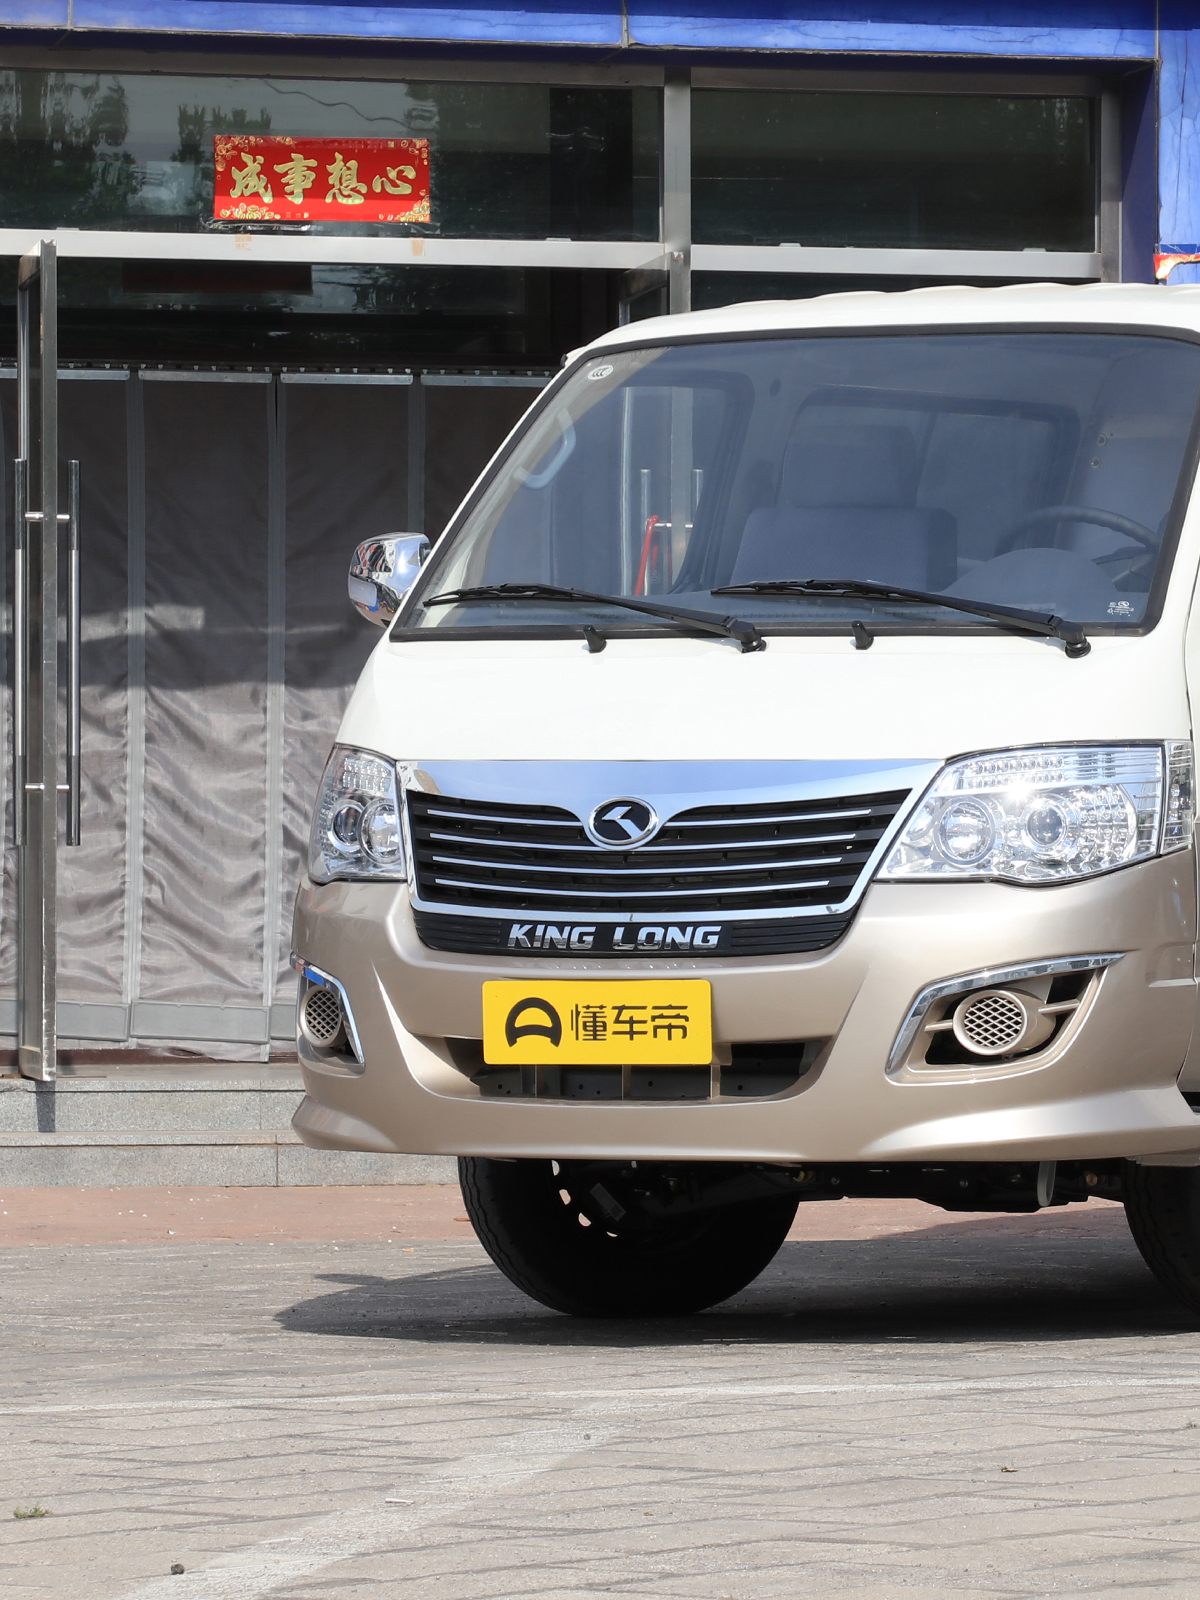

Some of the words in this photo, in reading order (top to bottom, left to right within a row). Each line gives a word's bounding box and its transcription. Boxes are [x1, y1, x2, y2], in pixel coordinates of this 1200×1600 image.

[507, 923, 597, 950] KING
[611, 925, 722, 950] LONG
[570, 1003, 690, 1041] 懂车帝
